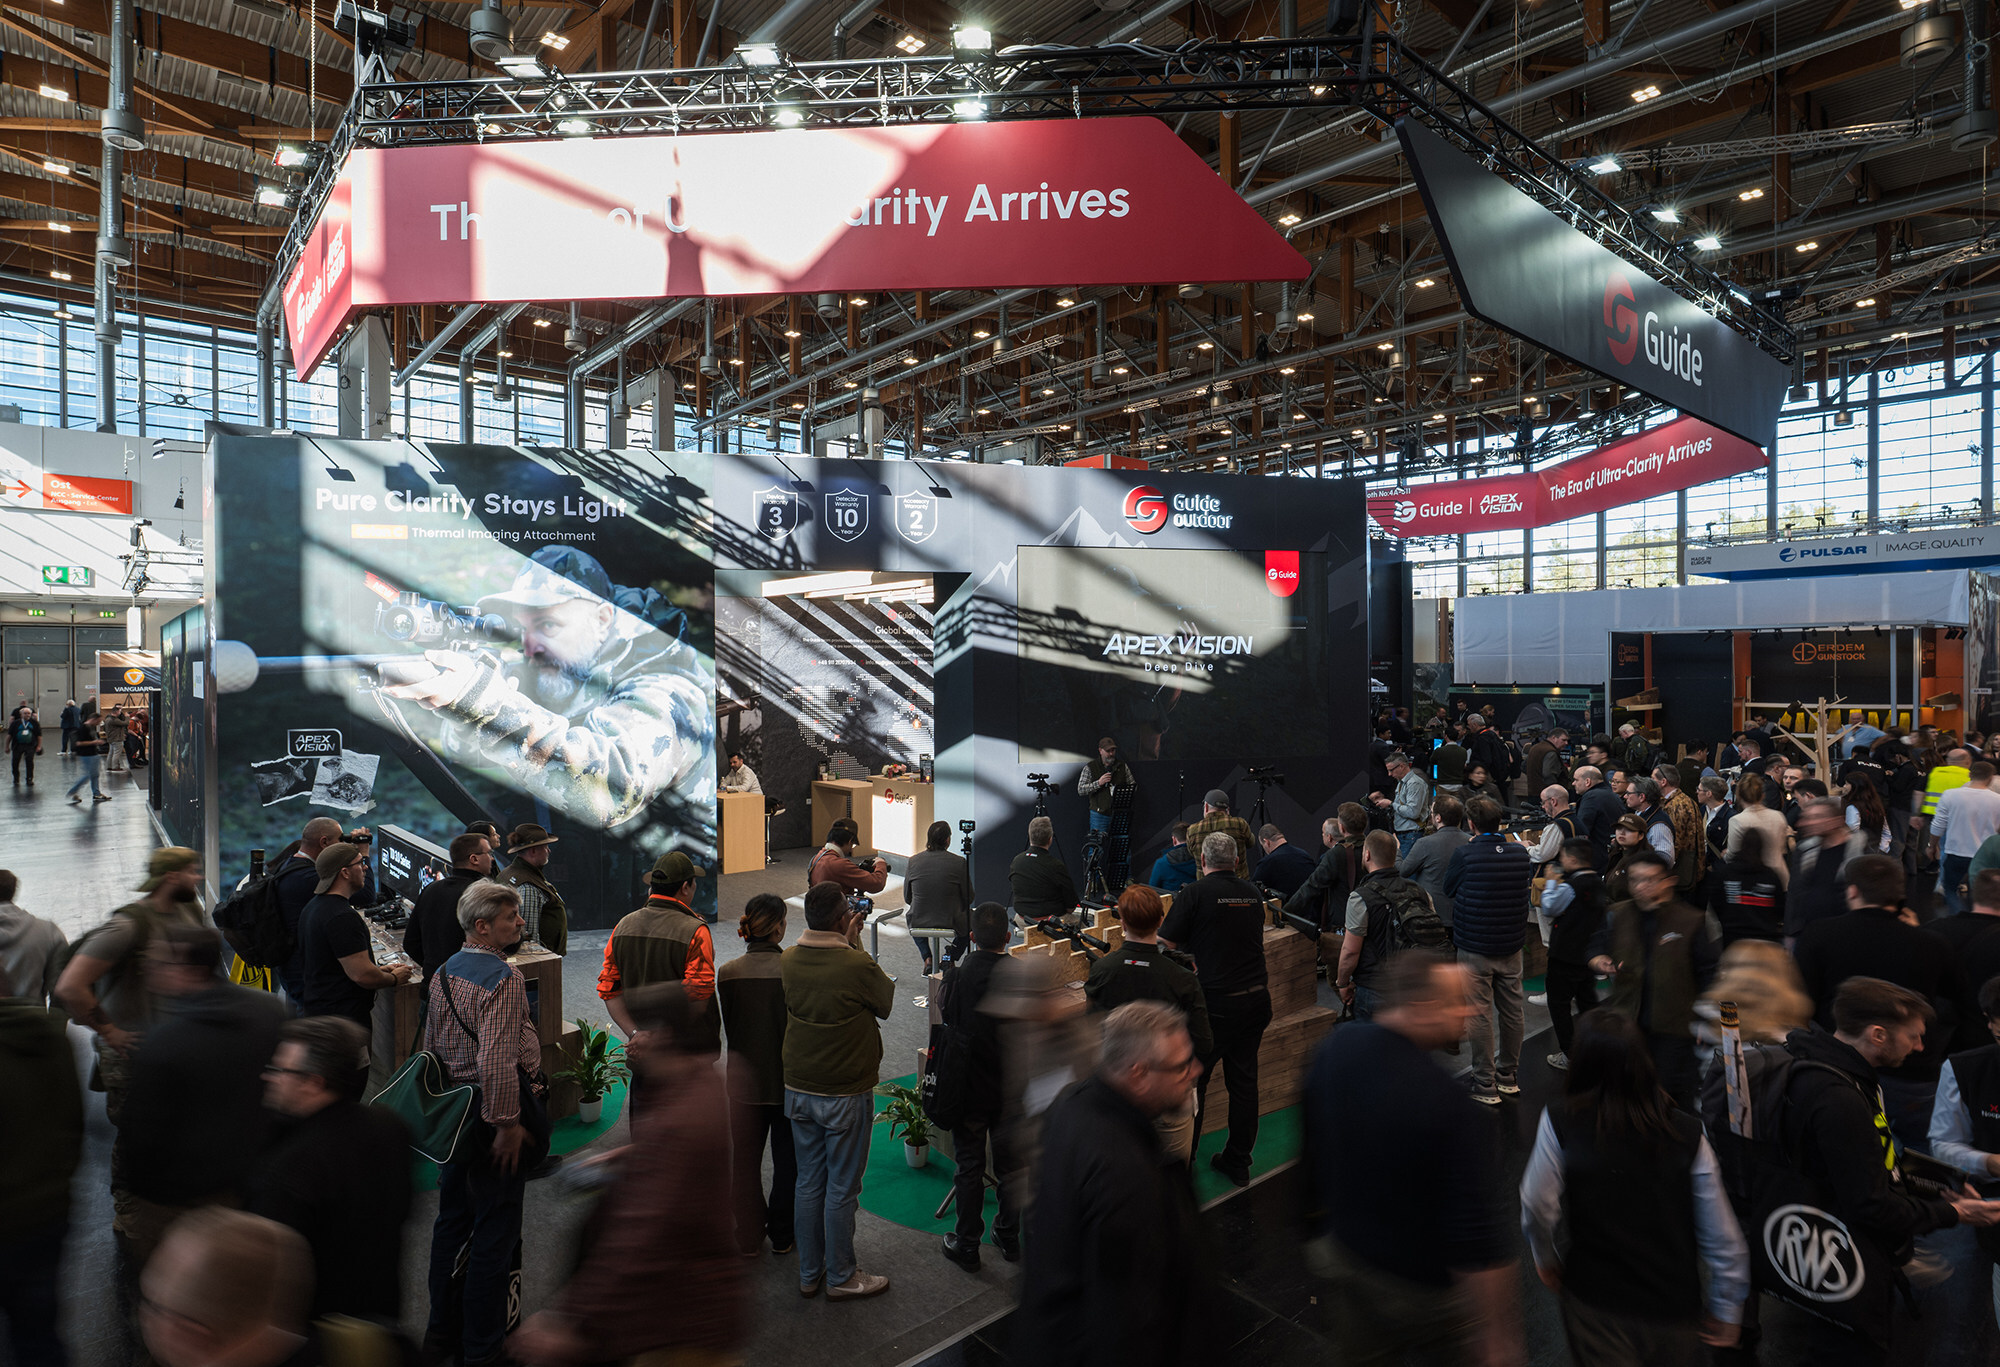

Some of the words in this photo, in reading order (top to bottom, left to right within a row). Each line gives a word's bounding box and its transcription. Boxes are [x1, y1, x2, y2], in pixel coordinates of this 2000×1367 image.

[430, 201, 482, 241] Th
[964, 182, 1130, 223] Arrives
[1643, 311, 1704, 388] Guide
[1550, 484, 1567, 502] The
[1567, 480, 1583, 495] Era
[1584, 472, 1596, 491] of
[1596, 452, 1664, 488] Ultra-Clarity
[1666, 436, 1713, 465] Arrives
[50, 480, 71, 490] Ost
[50, 498, 82, 507] Ausgang
[71, 492, 119, 502] Service-Center
[762, 499, 789, 507] Warranty
[1173, 493, 1221, 514] Guide
[1479, 492, 1519, 506] APEX
[315, 487, 378, 512] Pure
[383, 489, 476, 520] Clarity
[483, 492, 557, 522] Stays
[562, 494, 628, 524] Light
[834, 501, 860, 509] Warranty
[1420, 501, 1463, 518] Guide
[1480, 502, 1524, 515] VISION
[768, 506, 783, 526] 3
[835, 508, 859, 528] 10
[909, 510, 924, 529] 2
[1173, 513, 1234, 529] outdoor
[412, 526, 465, 540] Thermal
[467, 527, 520, 543] Imaging
[523, 529, 596, 542] Attachment
[1885, 536, 1985, 552] IMAGE.QUALITY
[1800, 545, 1868, 558] PULSAR
[1278, 570, 1297, 579] Guide
[874, 625, 901, 635] Global
[902, 626, 930, 635] Service
[1818, 643, 1865, 652] ERDEM
[1817, 652, 1866, 661] GUNSTOCK
[1144, 662, 1177, 674] Deep
[1185, 662, 1215, 672] Dive
[294, 734, 332, 743] APEX
[295, 743, 336, 752] VISION
[1775, 1213, 1850, 1292] RWS
